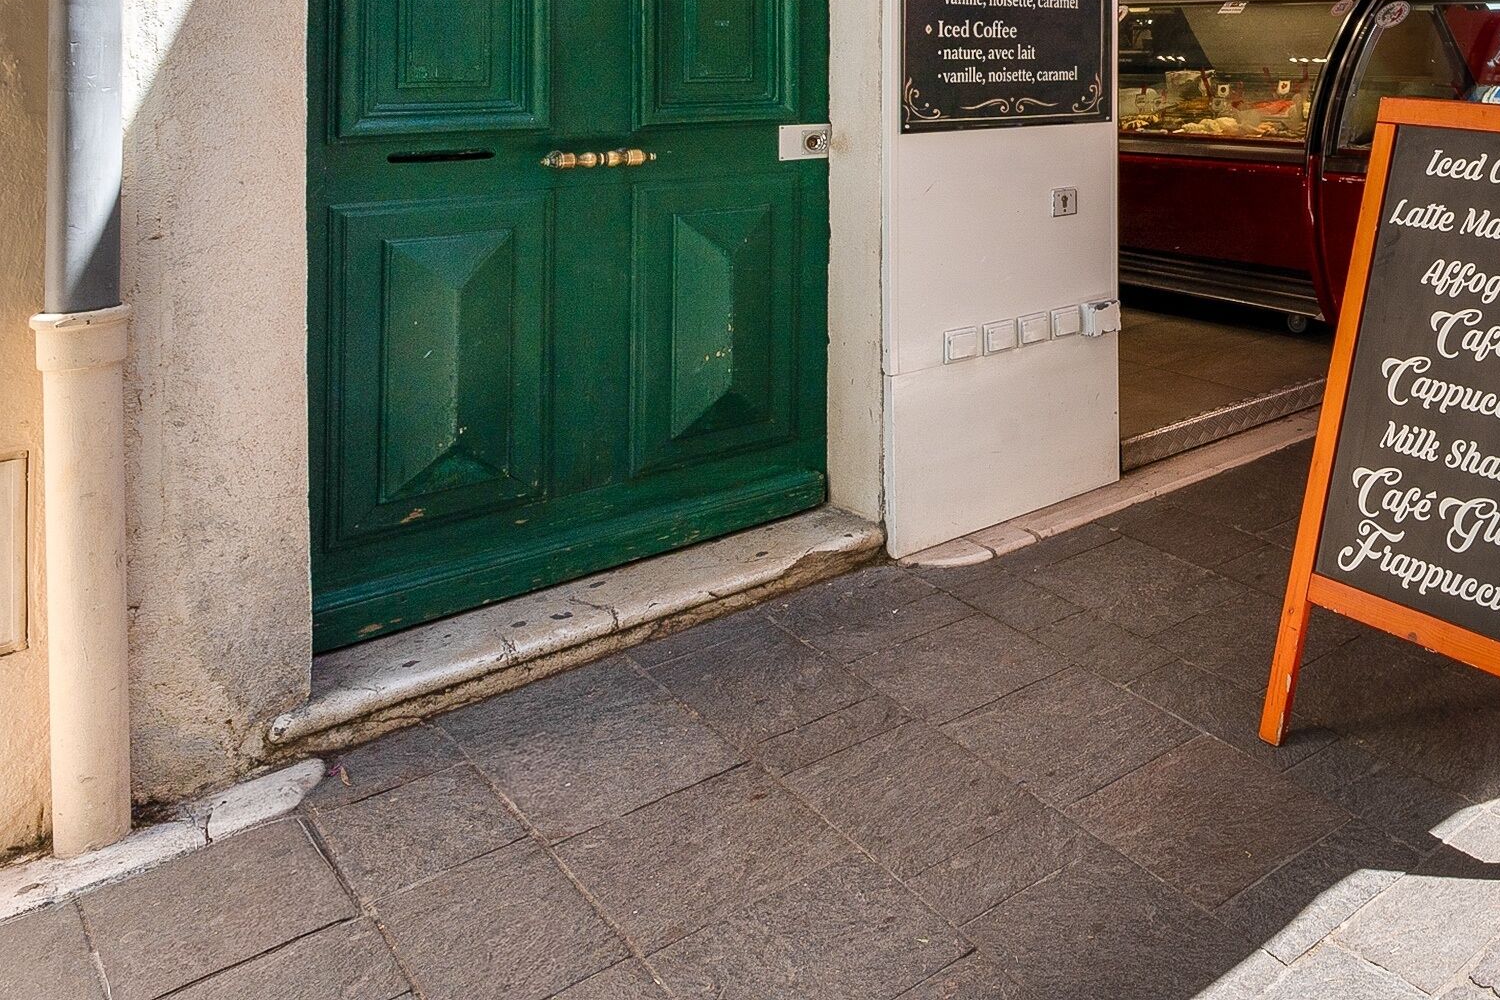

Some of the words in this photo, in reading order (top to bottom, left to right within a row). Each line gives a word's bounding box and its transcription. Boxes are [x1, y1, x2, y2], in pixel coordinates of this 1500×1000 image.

[938, 21, 970, 38] Iced
[973, 21, 1018, 38] Coffee
[943, 46, 986, 62] nature,
[988, 48, 1014, 60] avec
[1017, 44, 1036, 60] lait
[943, 67, 986, 84] vanille,
[988, 67, 1035, 84] noisette,
[1036, 66, 1078, 82] caramel
[1426, 149, 1487, 181] Iced
[1389, 199, 1454, 232] Latte
[1380, 420, 1438, 462] Milk
[1352, 467, 1437, 522] Café
